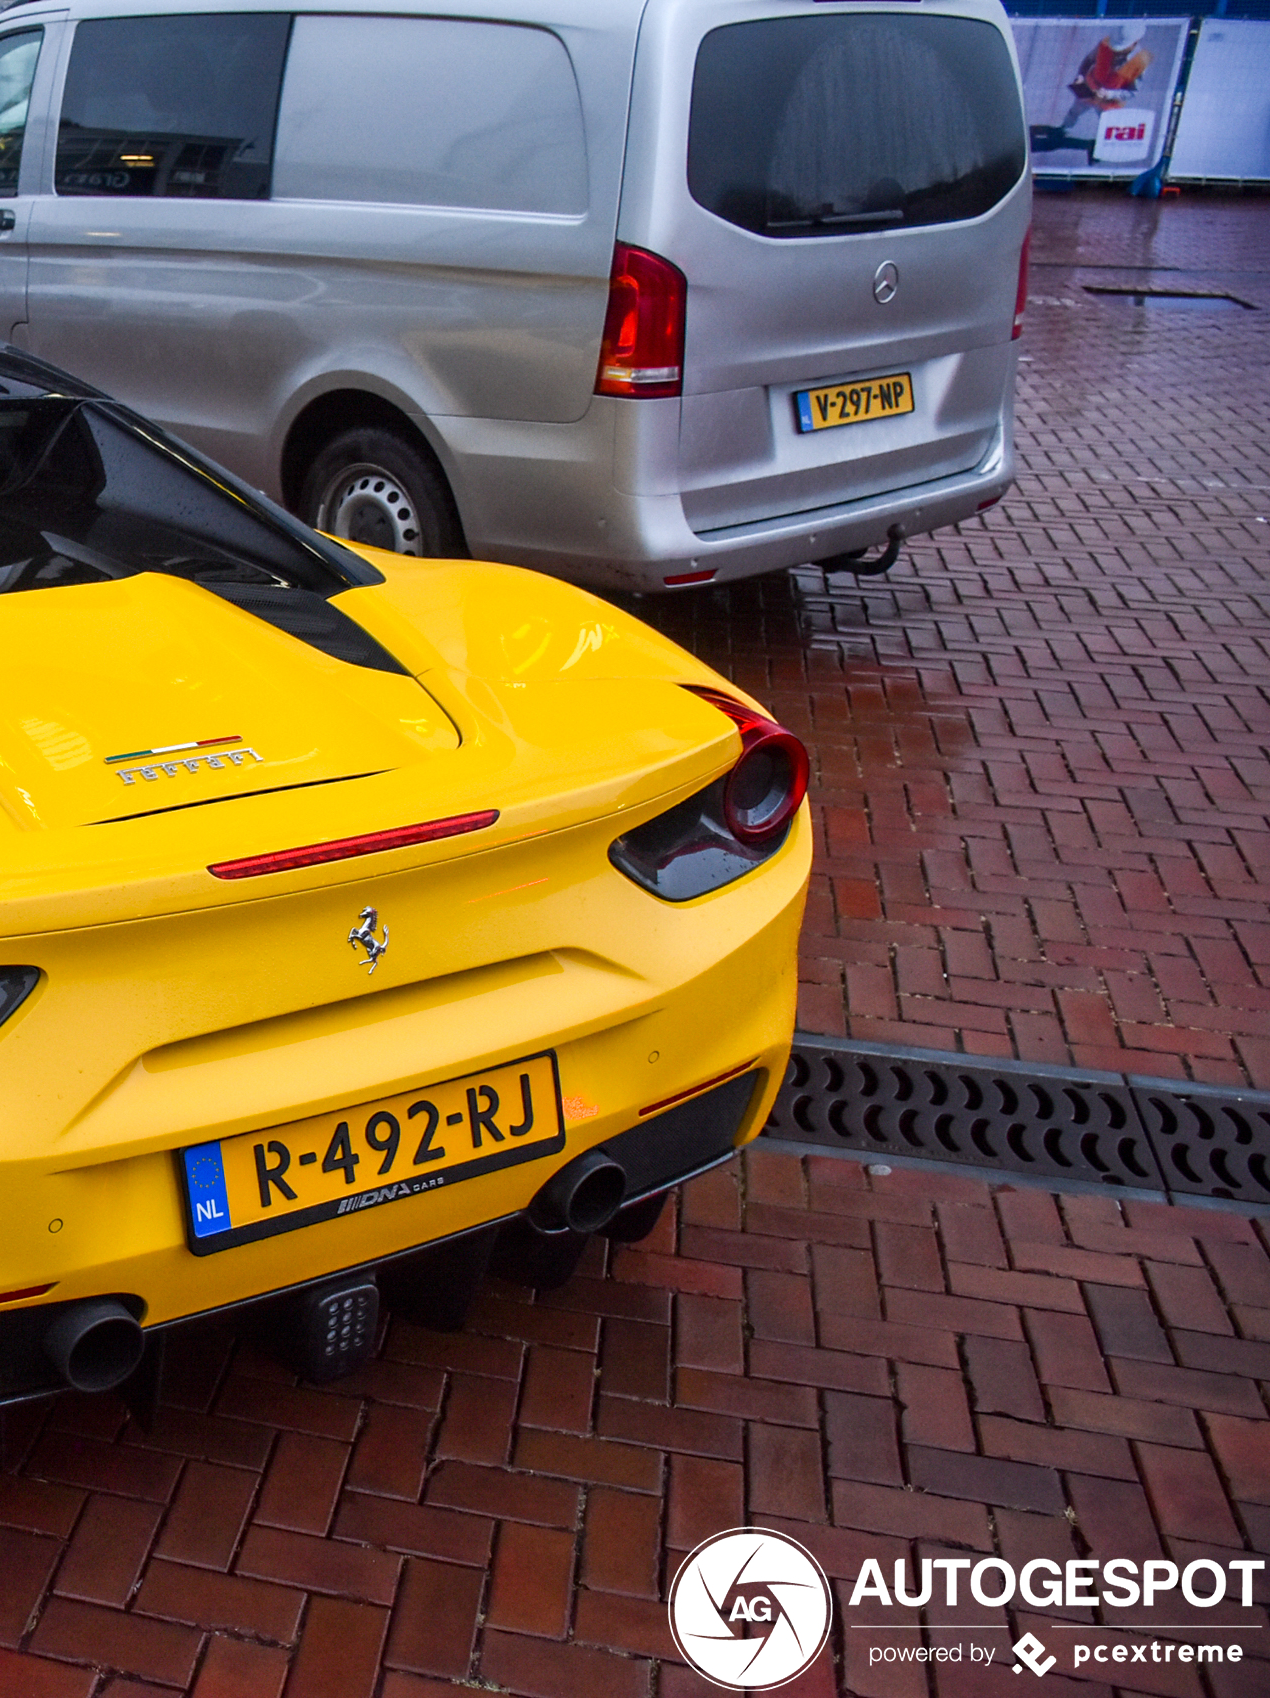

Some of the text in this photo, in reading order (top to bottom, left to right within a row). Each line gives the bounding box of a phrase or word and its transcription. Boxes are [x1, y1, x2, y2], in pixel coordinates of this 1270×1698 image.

[1104, 122, 1146, 141] rai
[816, 381, 905, 422] V-297-NP
[253, 1073, 535, 1208] R-492-RJ
[413, 1177, 445, 1192] CARS
[196, 1199, 224, 1223] NL
